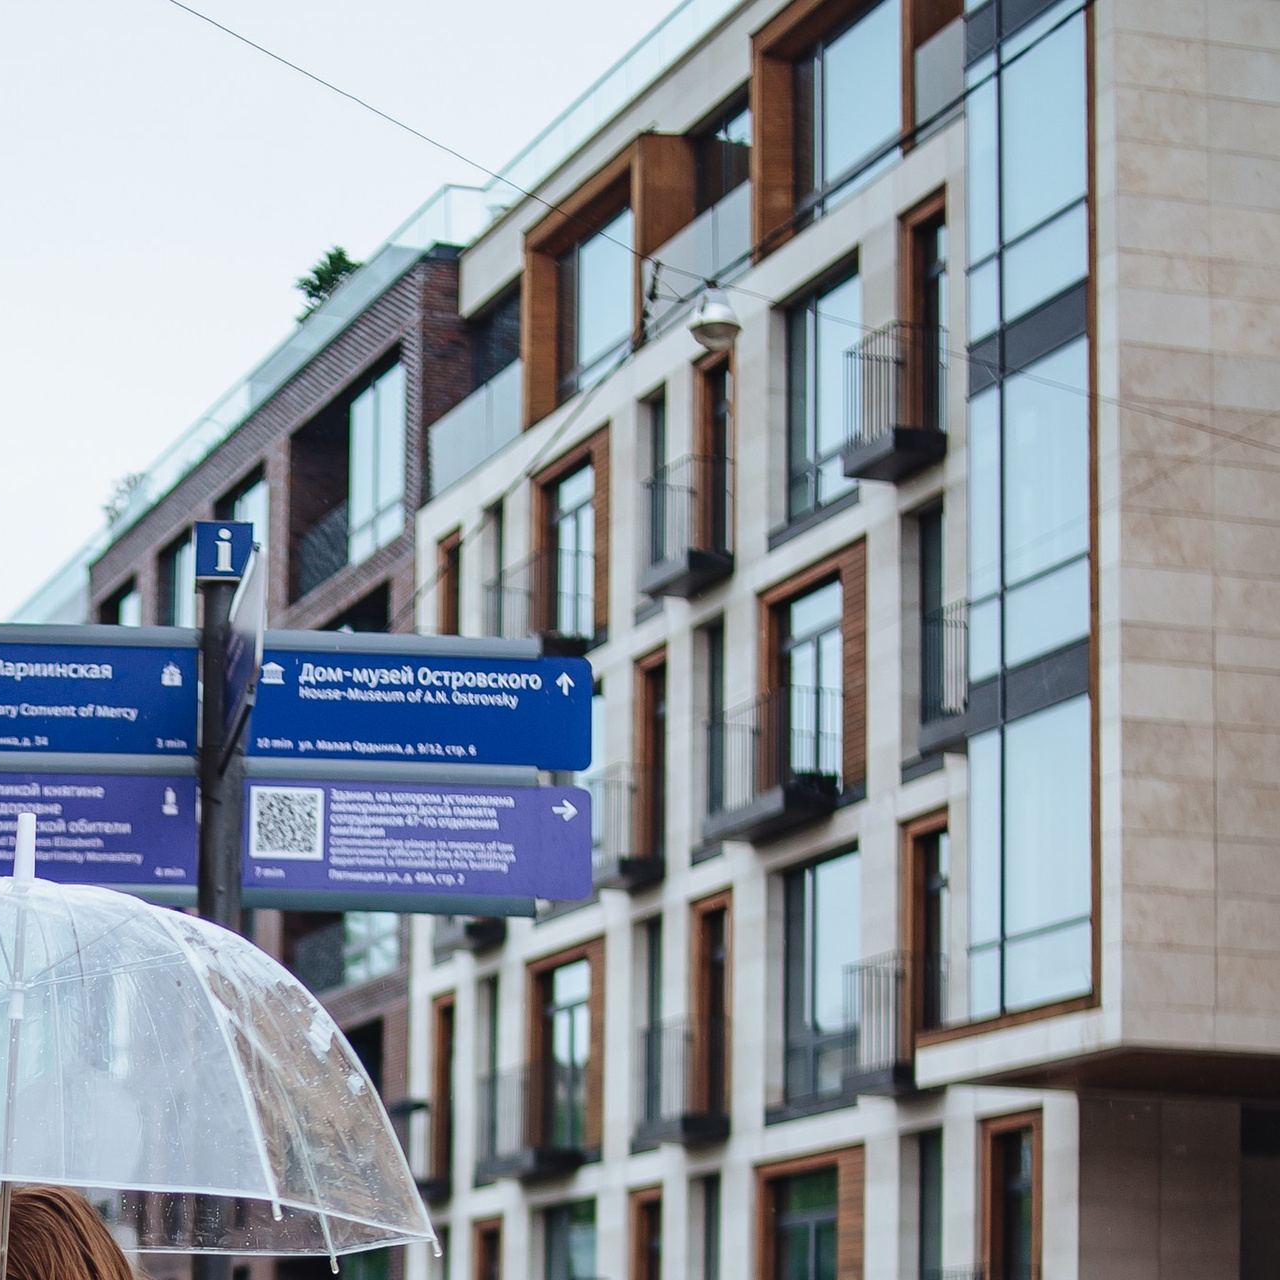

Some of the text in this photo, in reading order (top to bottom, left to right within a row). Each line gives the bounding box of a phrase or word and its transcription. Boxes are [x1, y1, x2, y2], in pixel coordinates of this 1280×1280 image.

[298, 662, 542, 690] Дом-музей Островского
[298, 685, 519, 710] House-Museum of A.N. Ostrovsky
[19, 703, 77, 717] Convent
[77, 703, 95, 717] of
[94, 705, 139, 721] Mercy
[164, 737, 187, 749] min
[271, 737, 294, 750] min
[298, 740, 316, 752] ул.
[315, 739, 352, 752] Малая
[444, 744, 468, 758] стр.
[468, 743, 477, 757] 6
[42, 784, 105, 799] княгине
[375, 791, 391, 803] на
[391, 792, 442, 805] котором
[442, 794, 515, 808] установлена
[330, 801, 497, 819] мемориальная доска памяти
[67, 818, 131, 833] обители
[330, 813, 405, 828] сотрудников
[437, 817, 500, 831] отделения
[53, 836, 104, 849] Elizabeth
[486, 841, 498, 852] of
[497, 842, 515, 853] law
[85, 851, 144, 866] Monastery
[153, 866, 187, 879] 4 min
[261, 866, 286, 878] min
